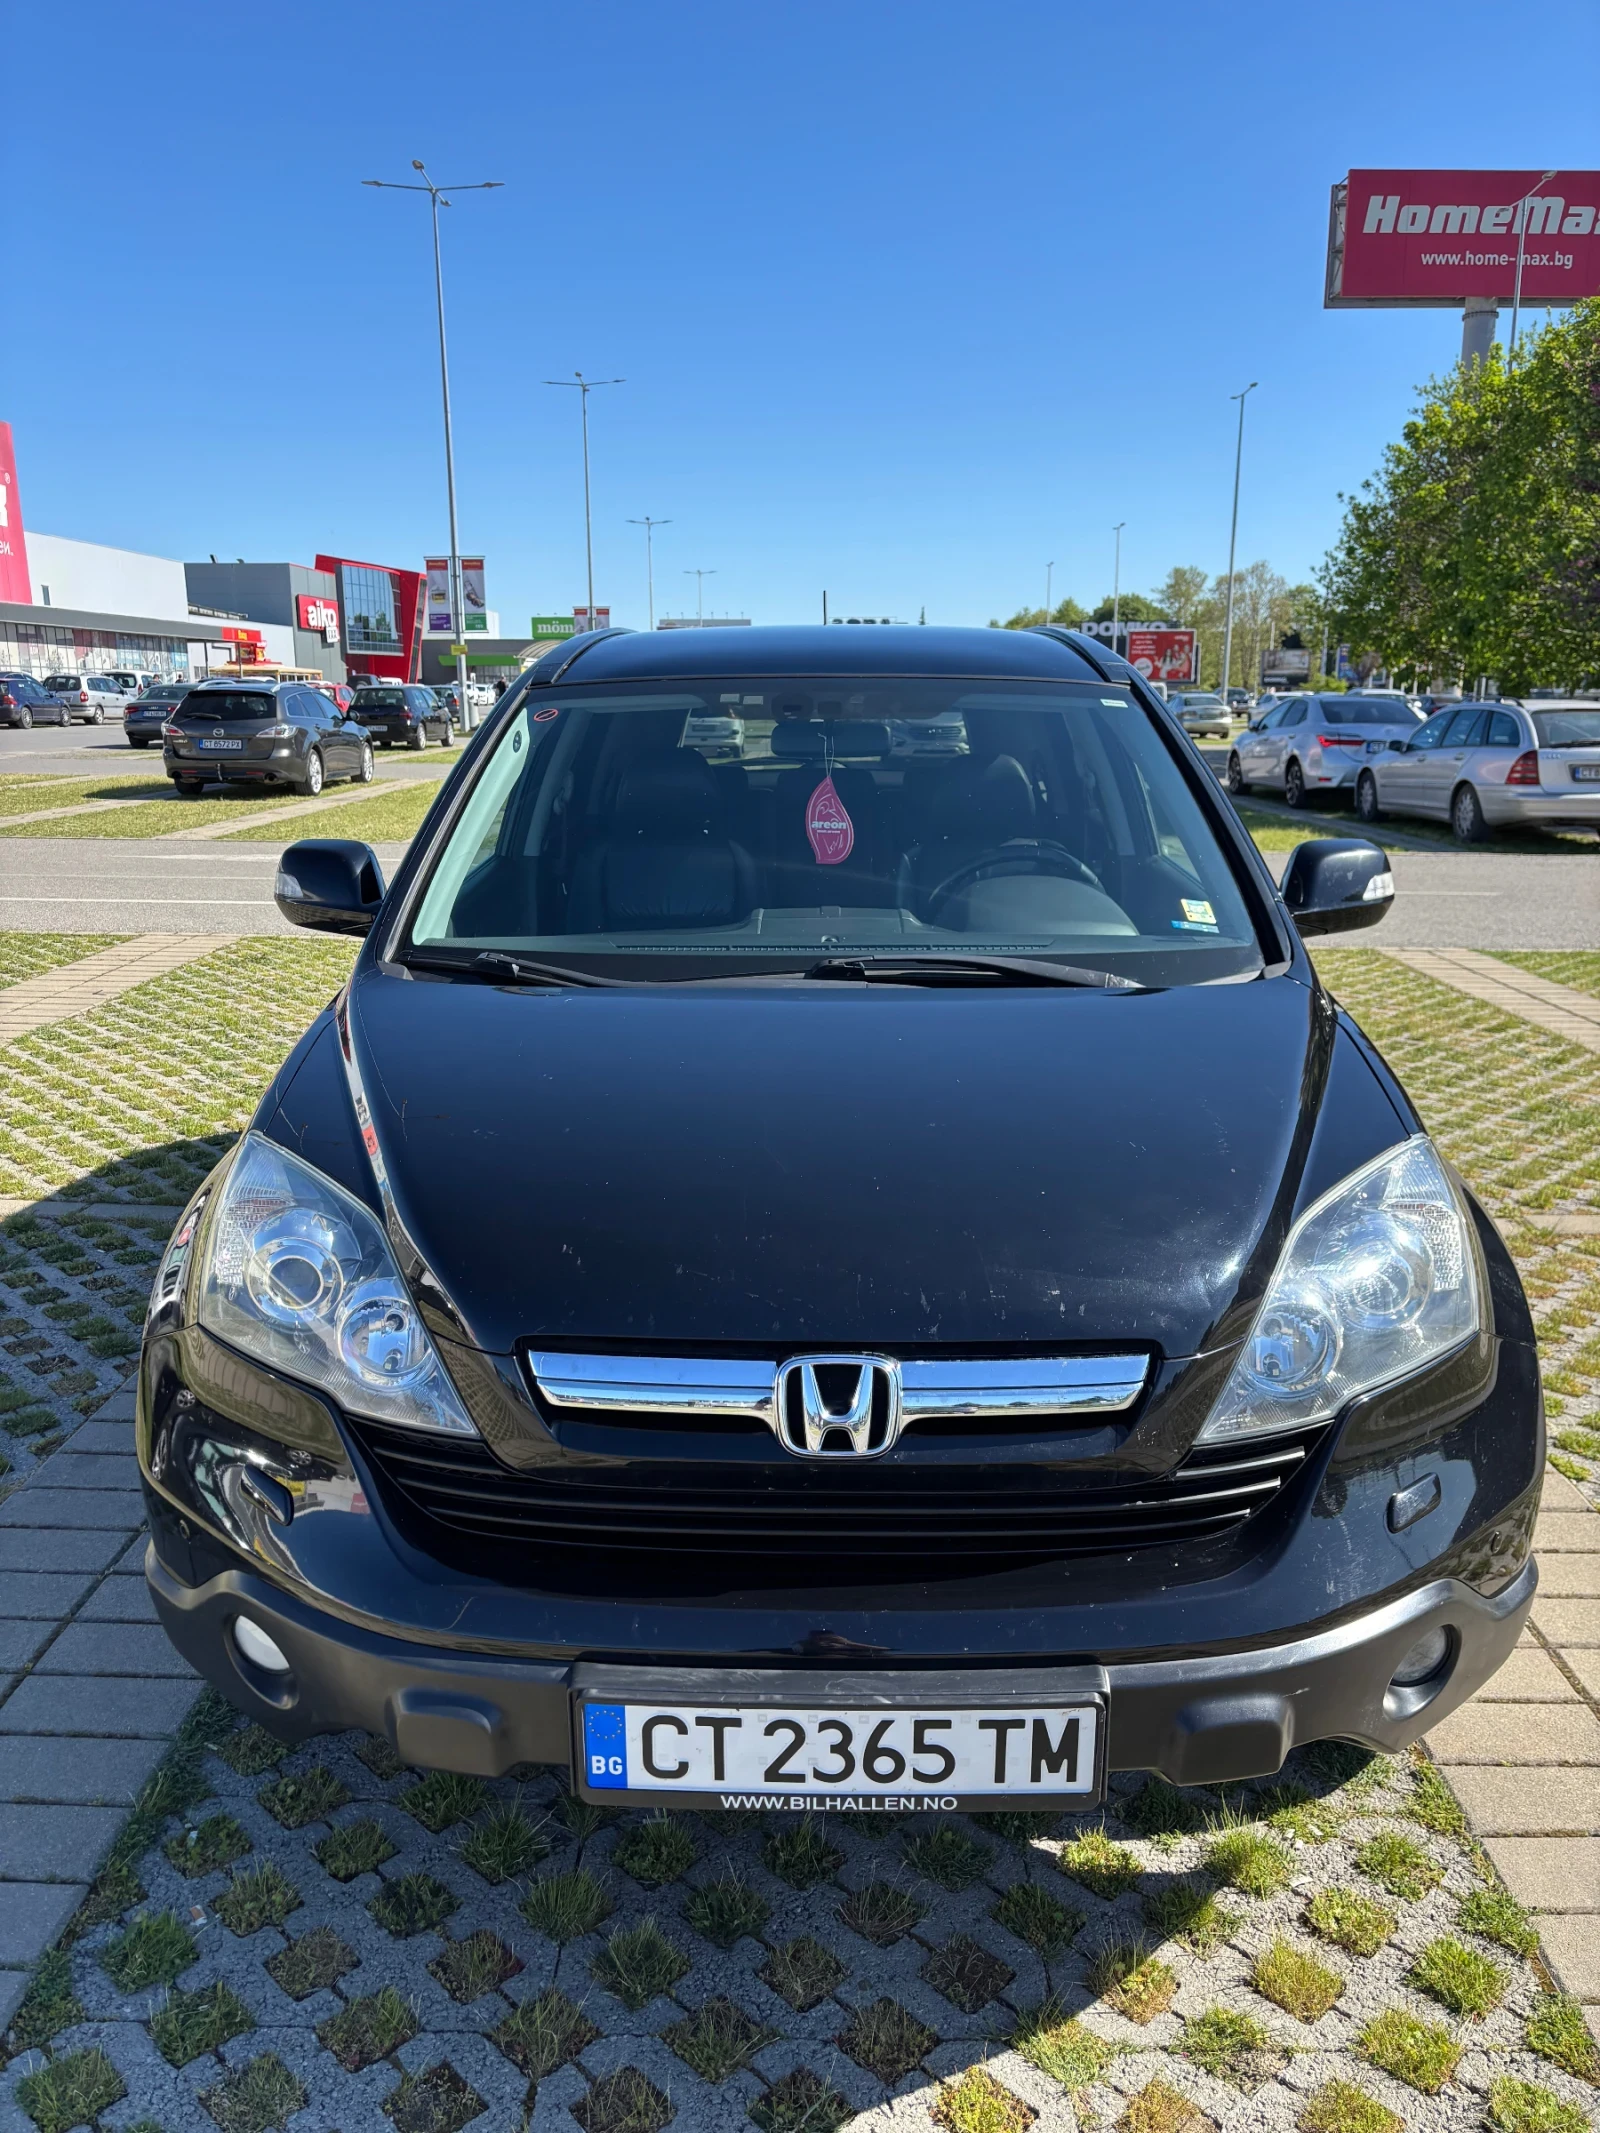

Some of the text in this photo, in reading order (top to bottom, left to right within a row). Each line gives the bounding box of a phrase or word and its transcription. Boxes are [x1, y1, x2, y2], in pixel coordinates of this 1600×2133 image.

[1362, 195, 1600, 235] HomeMa
[1421, 250, 1574, 270] www.home-max.bg
[307, 600, 337, 627] aiko
[811, 820, 847, 829] areon
[641, 1715, 1079, 1784] CT 2365 TM
[591, 1755, 623, 1775] BG
[720, 1795, 958, 1812] WWW.BILHALLEN.NO
